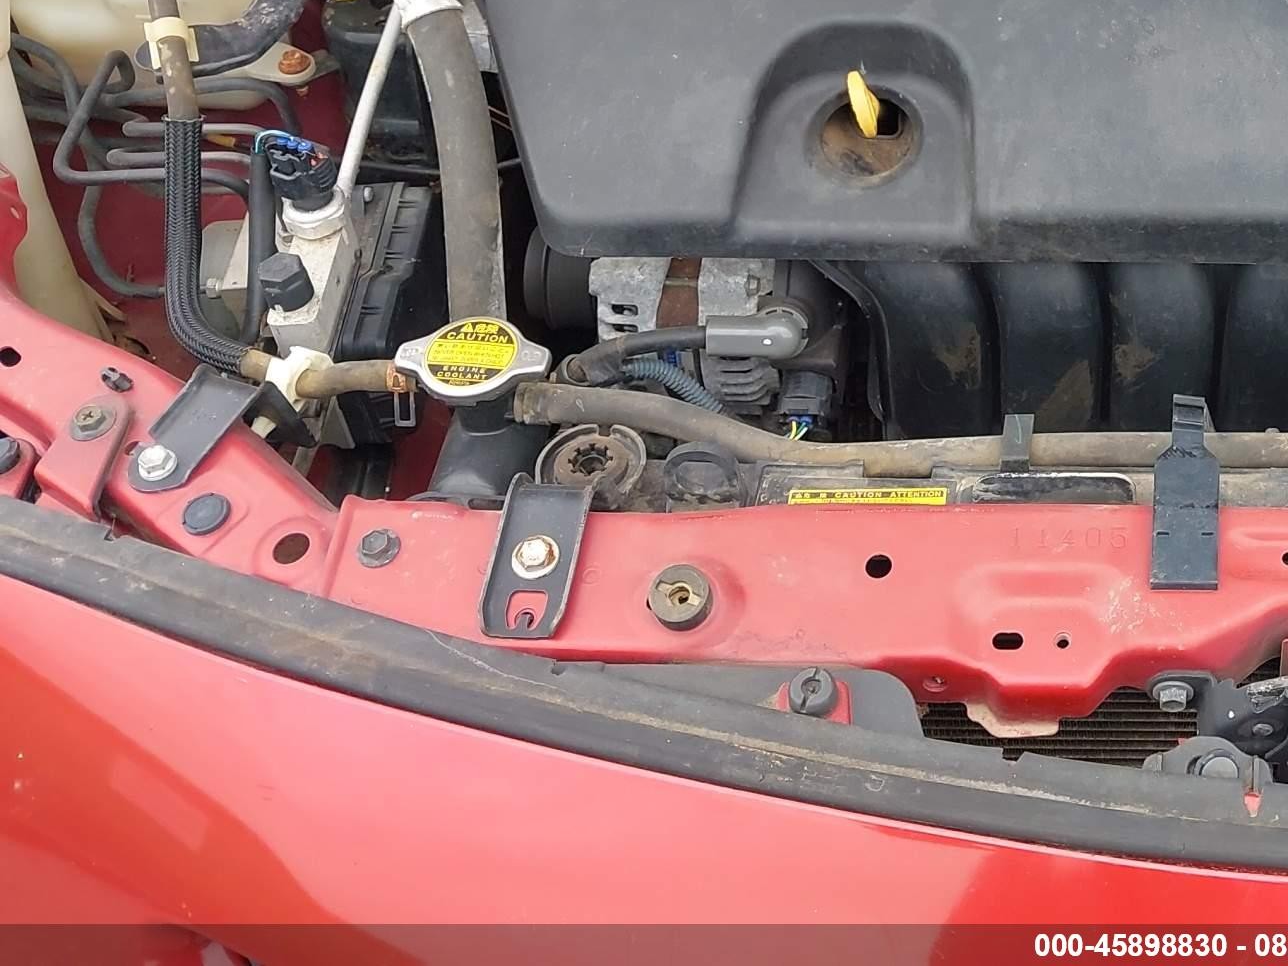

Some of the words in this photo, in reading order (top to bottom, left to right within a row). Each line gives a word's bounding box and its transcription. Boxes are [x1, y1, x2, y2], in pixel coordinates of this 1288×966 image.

[446, 331, 509, 344] CAUTION
[443, 365, 487, 374] ENGINE
[436, 371, 489, 380] COOLANT
[834, 491, 882, 499] CAUTION
[890, 490, 942, 498] ATTENTION
